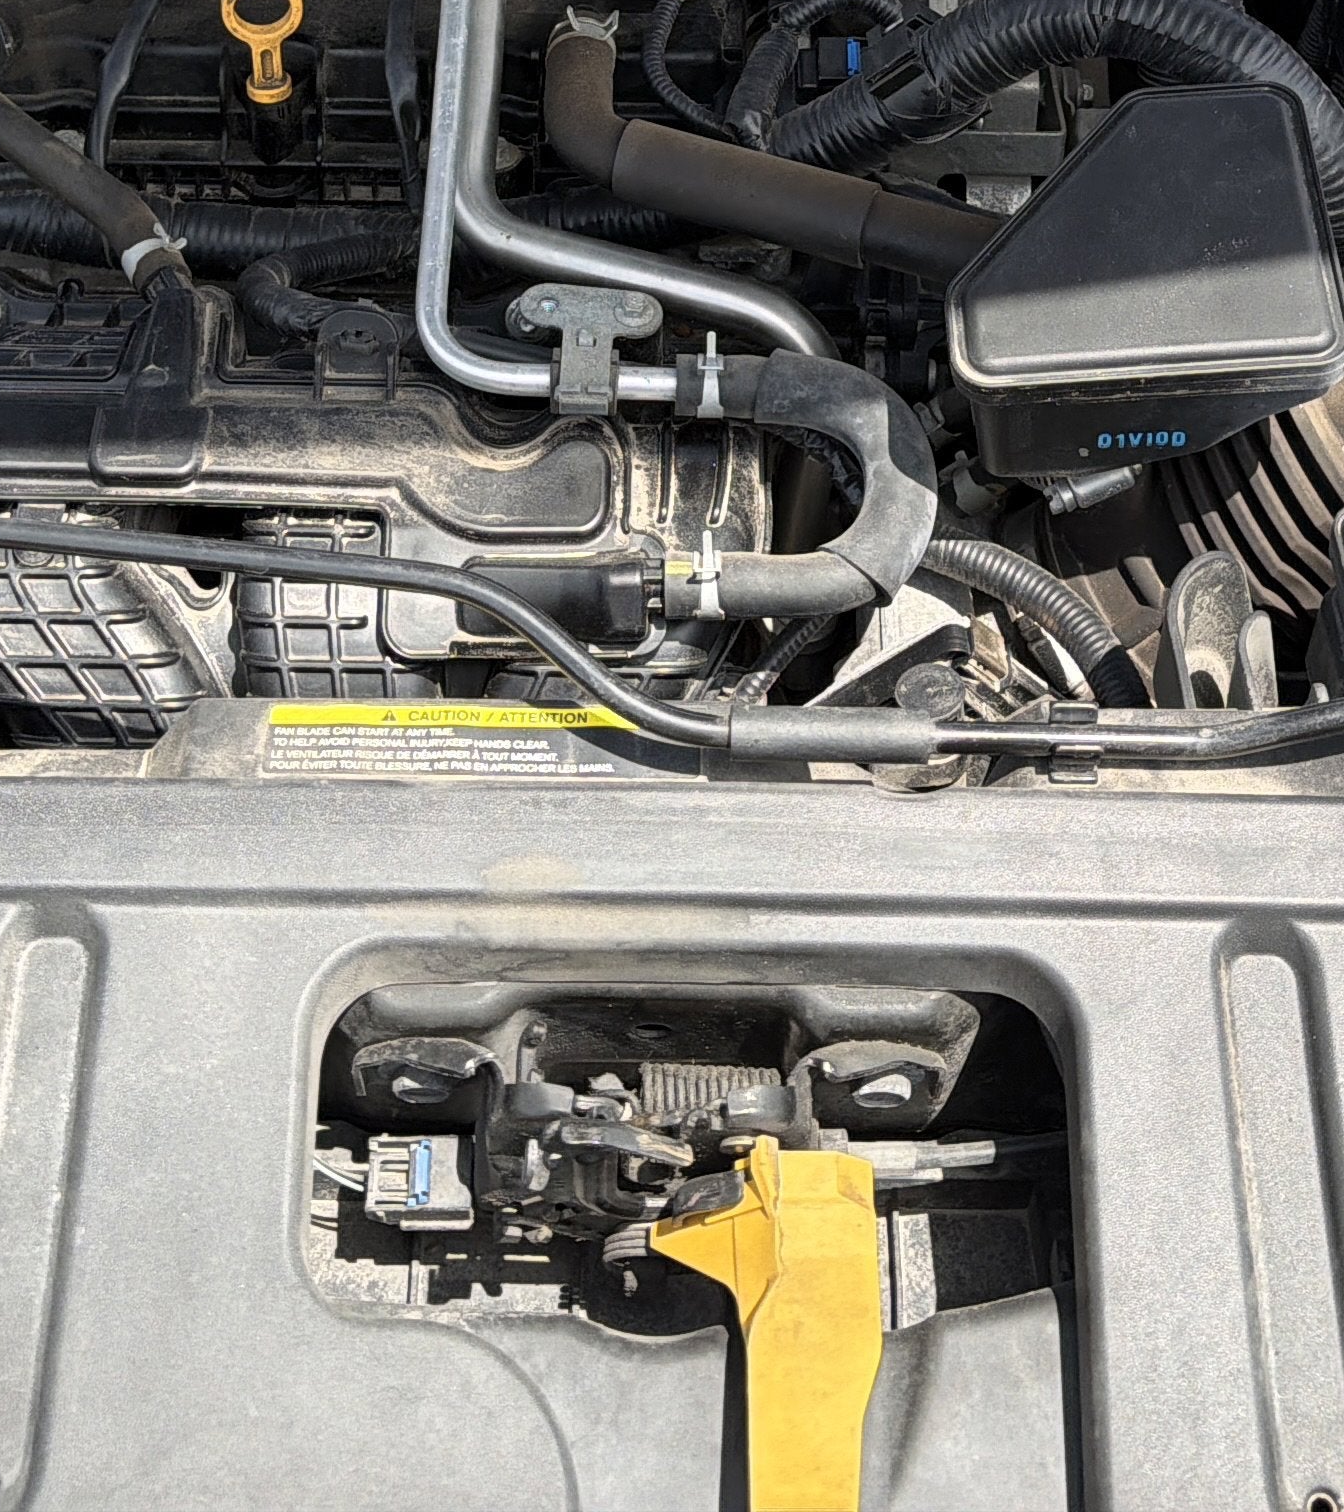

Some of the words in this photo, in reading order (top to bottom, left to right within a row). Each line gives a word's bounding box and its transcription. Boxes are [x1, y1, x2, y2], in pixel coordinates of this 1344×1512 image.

[408, 710, 481, 722] CAUTION
[499, 711, 588, 724] ATTENTION
[274, 727, 295, 736] FAN
[296, 727, 331, 736] BLADE
[332, 726, 356, 736] CAN
[358, 727, 390, 736] START
[391, 727, 405, 736] AT
[406, 727, 428, 737] ANY
[429, 728, 455, 737] TIME.
[273, 737, 288, 746] TO
[291, 737, 318, 747] HELP
[318, 738, 350, 747] AVOID
[352, 738, 408, 748] PERSONAL
[473, 740, 512, 749] HANDS
[512, 739, 550, 750] CLEAR.
[271, 750, 284, 759] LE
[286, 749, 354, 759] VENTILATEUR
[355, 750, 395, 760] RISQUE
[396, 750, 410, 760] DE
[413, 748, 471, 760] DÉMARRER
[481, 751, 510, 761] TOUT
[511, 752, 559, 762] MOMENT.
[270, 760, 302, 770] POUR
[303, 759, 337, 770] ÉVITER
[339, 760, 374, 770] TOUTE
[375, 761, 433, 772] BLESSURE,
[434, 761, 449, 771] NE
[450, 761, 472, 771] PAS
[473, 762, 488, 772] EN
[489, 763, 556, 773] APPROCHER
[557, 763, 578, 773] LES
[578, 763, 616, 774] MAINS.
